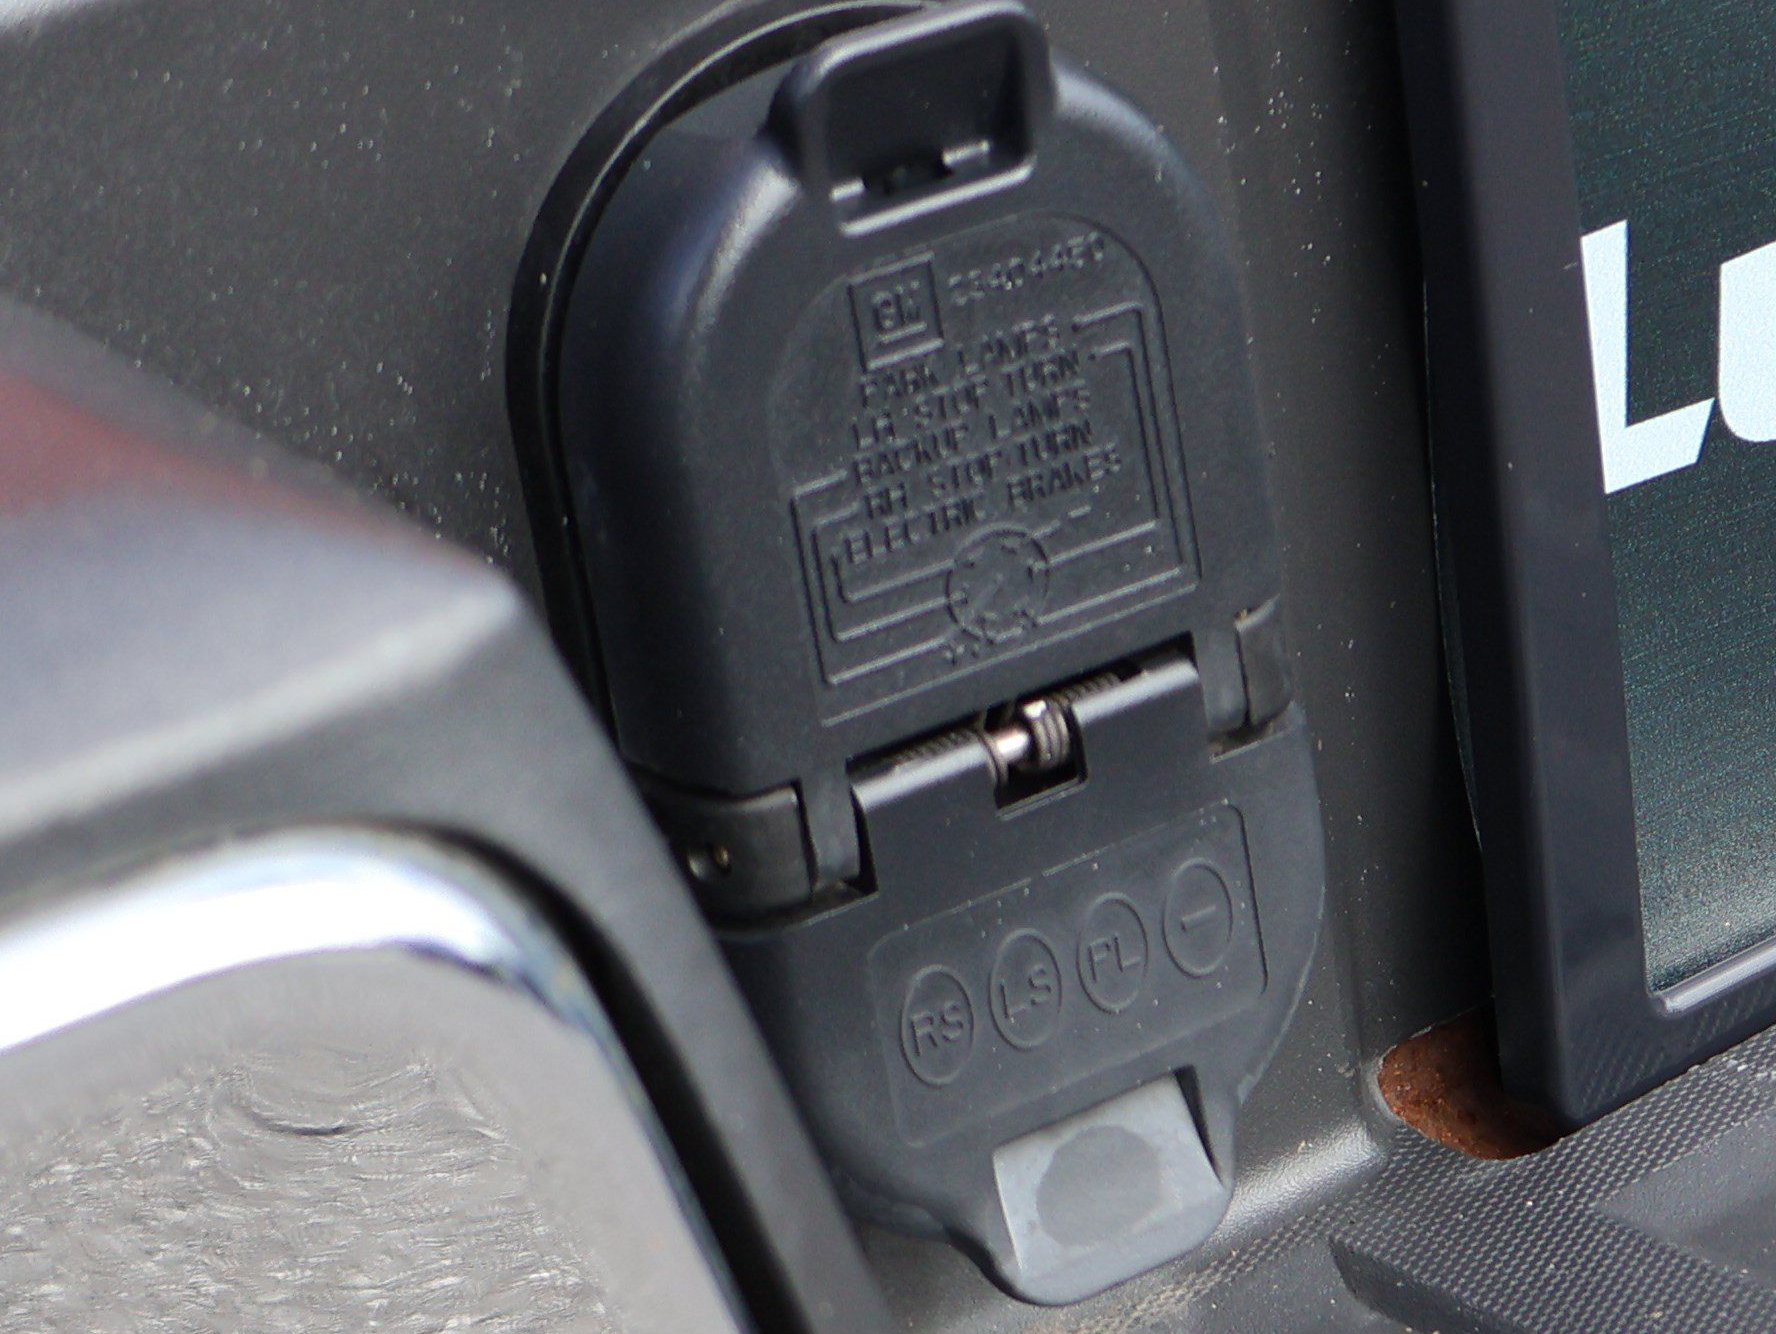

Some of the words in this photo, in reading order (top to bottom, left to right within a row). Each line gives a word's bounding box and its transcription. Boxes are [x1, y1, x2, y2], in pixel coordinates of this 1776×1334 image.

[859, 363, 940, 410] PARK
[955, 314, 1060, 373] LAMPS
[913, 372, 990, 427] STOP
[1002, 347, 1079, 398] TURN
[986, 378, 1092, 441] LAMPS
[843, 496, 987, 565] ELECTRIC
[1005, 440, 1122, 510] BRAKES
[863, 478, 908, 520] RH
[926, 446, 1001, 498] STOP
[1014, 416, 1092, 468] TURN
[910, 1000, 964, 1058] RS
[1000, 962, 1053, 1020] LS
[1086, 931, 1142, 985] PL
